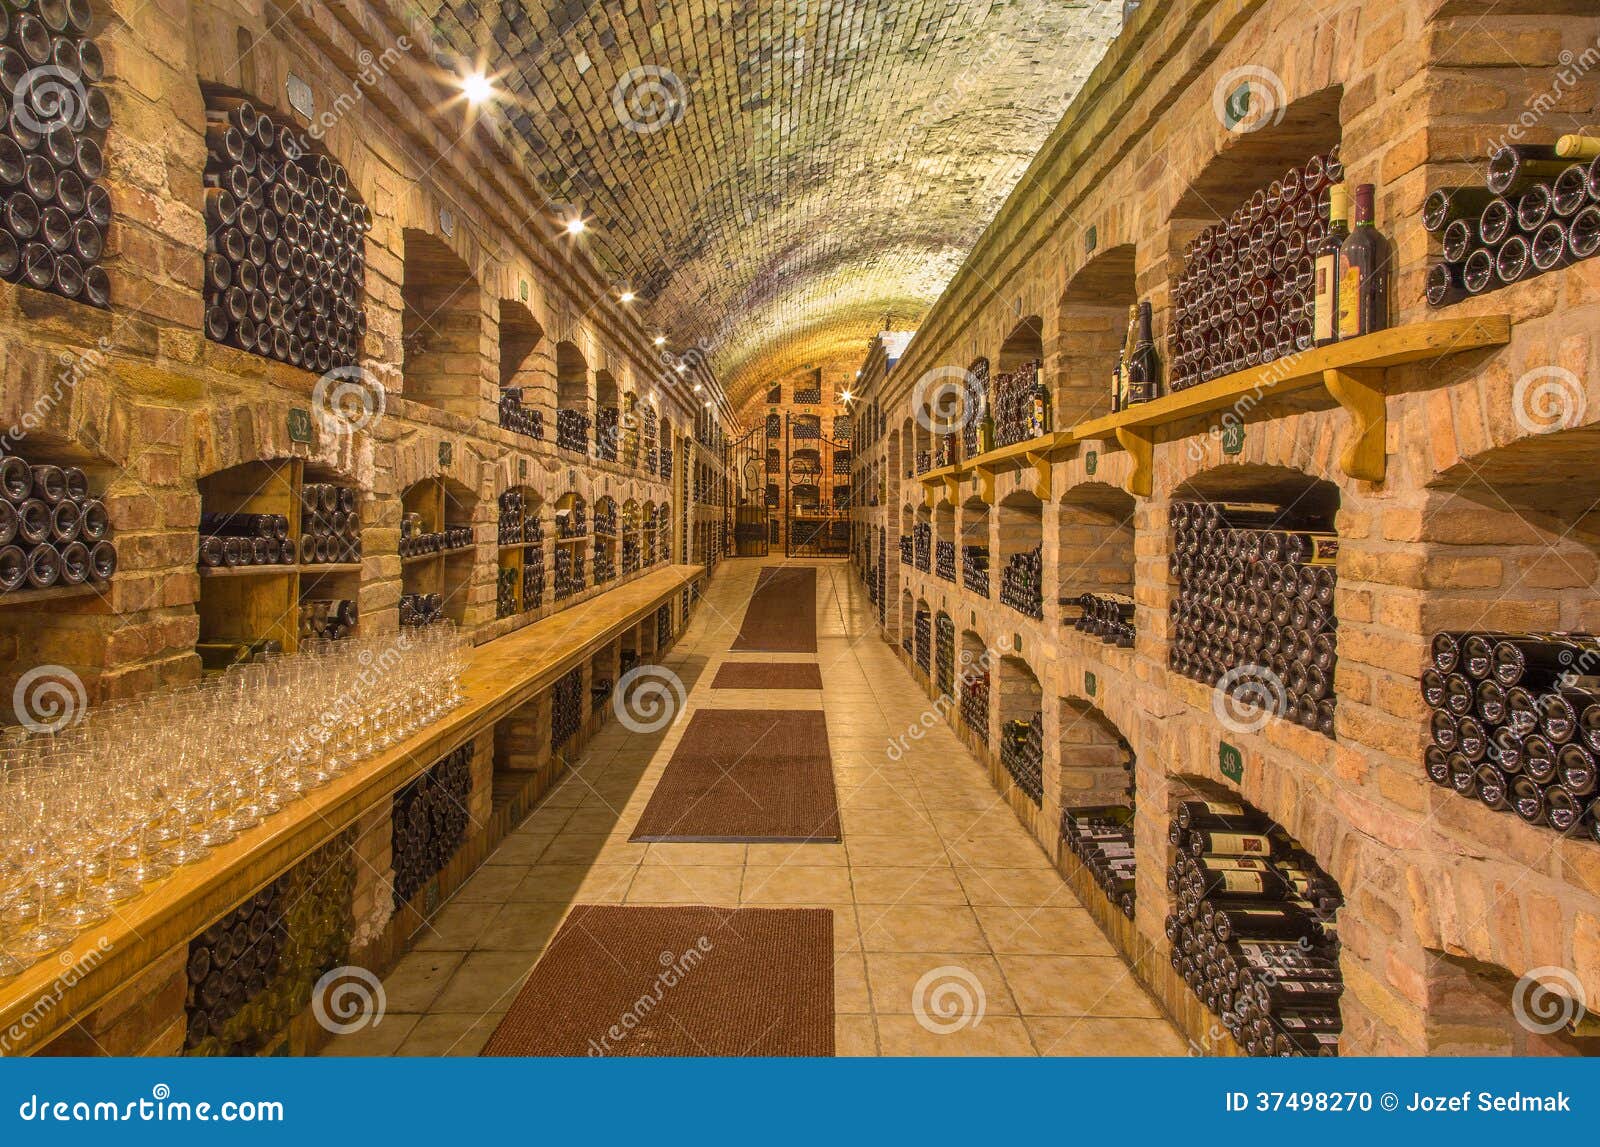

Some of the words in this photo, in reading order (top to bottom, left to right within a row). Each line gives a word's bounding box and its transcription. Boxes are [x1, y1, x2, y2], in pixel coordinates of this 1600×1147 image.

[294, 414, 308, 437] 32
[1225, 426, 1238, 448] 28
[1223, 750, 1236, 773] 48
